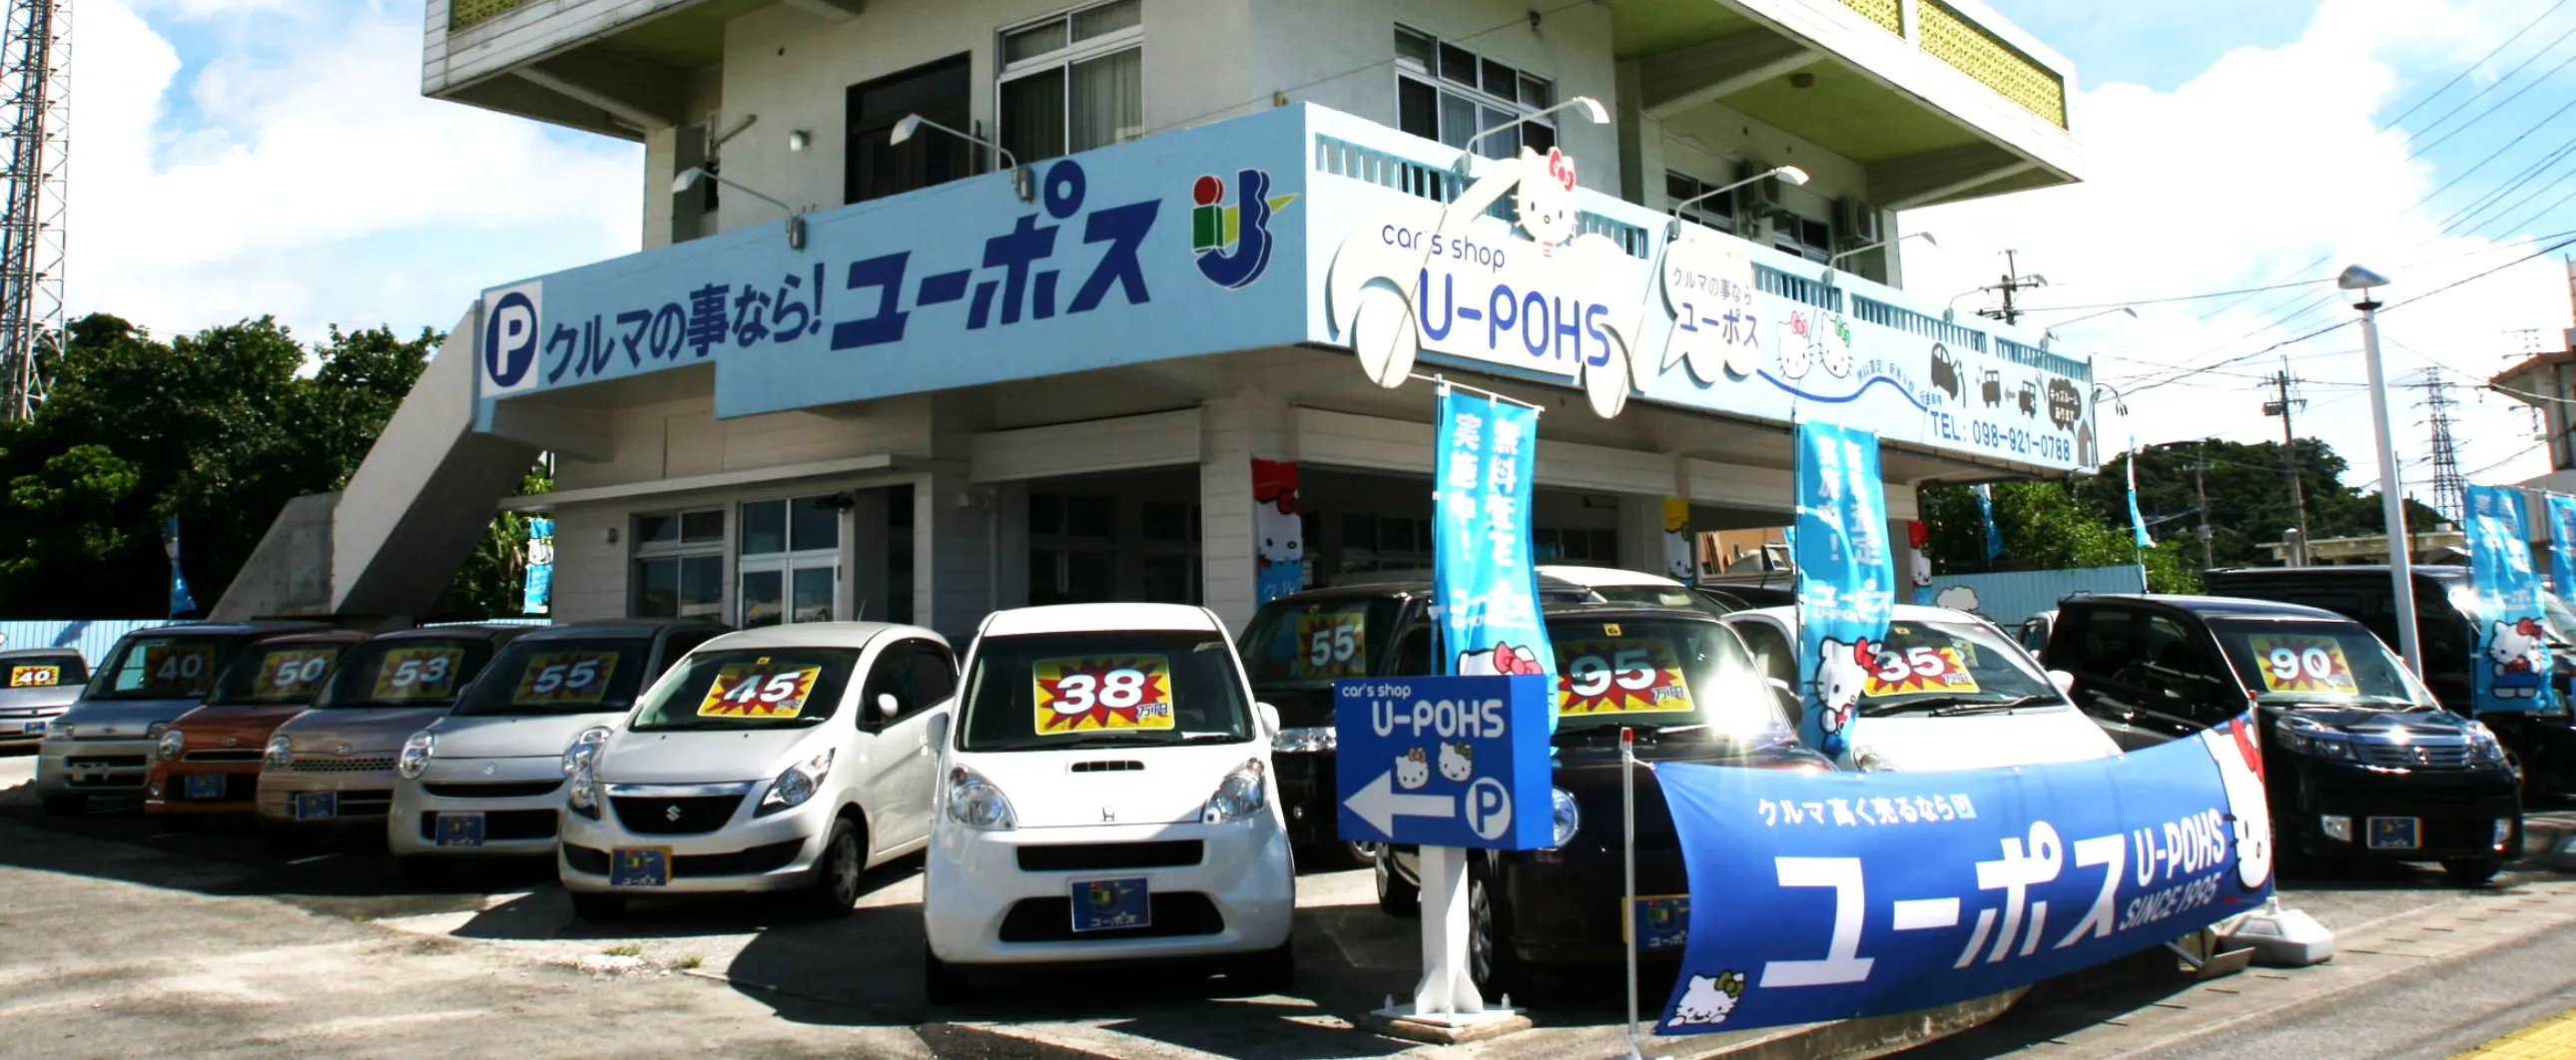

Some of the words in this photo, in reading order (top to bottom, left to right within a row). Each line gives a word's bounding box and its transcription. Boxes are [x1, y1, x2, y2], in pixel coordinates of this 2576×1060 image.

[1382, 225, 1443, 256] car's
[1453, 236, 1505, 272] shop
[545, 263, 824, 383] クルマの事なら!
[831, 160, 1163, 350] ユーポス
[1673, 266, 1752, 305] クルマの事なら
[1419, 267, 1610, 367] U-POHS
[1679, 302, 1758, 349] ユーポス
[1973, 419, 2070, 462] 098-921-0788
[157, 653, 203, 680] 40
[1310, 623, 1355, 667] 55
[1875, 646, 1945, 682] 35
[2270, 647, 2331, 680] 90
[18, 669, 50, 685] 40
[274, 657, 325, 687] 50
[391, 656, 448, 688] 53
[533, 659, 599, 694] 55
[724, 672, 800, 705] 45
[1052, 668, 1145, 716] 38
[1342, 683, 1375, 698] car's
[1377, 683, 1412, 700] shop
[1570, 649, 1656, 697] 95
[1372, 699, 1505, 739] U-POHS
[1476, 783, 1504, 833] P
[2133, 807, 2226, 887] U-POHS
[1759, 820, 2126, 988] ユーポス
[2118, 884, 2184, 931] SINCE
[2176, 871, 2223, 914] 1995
